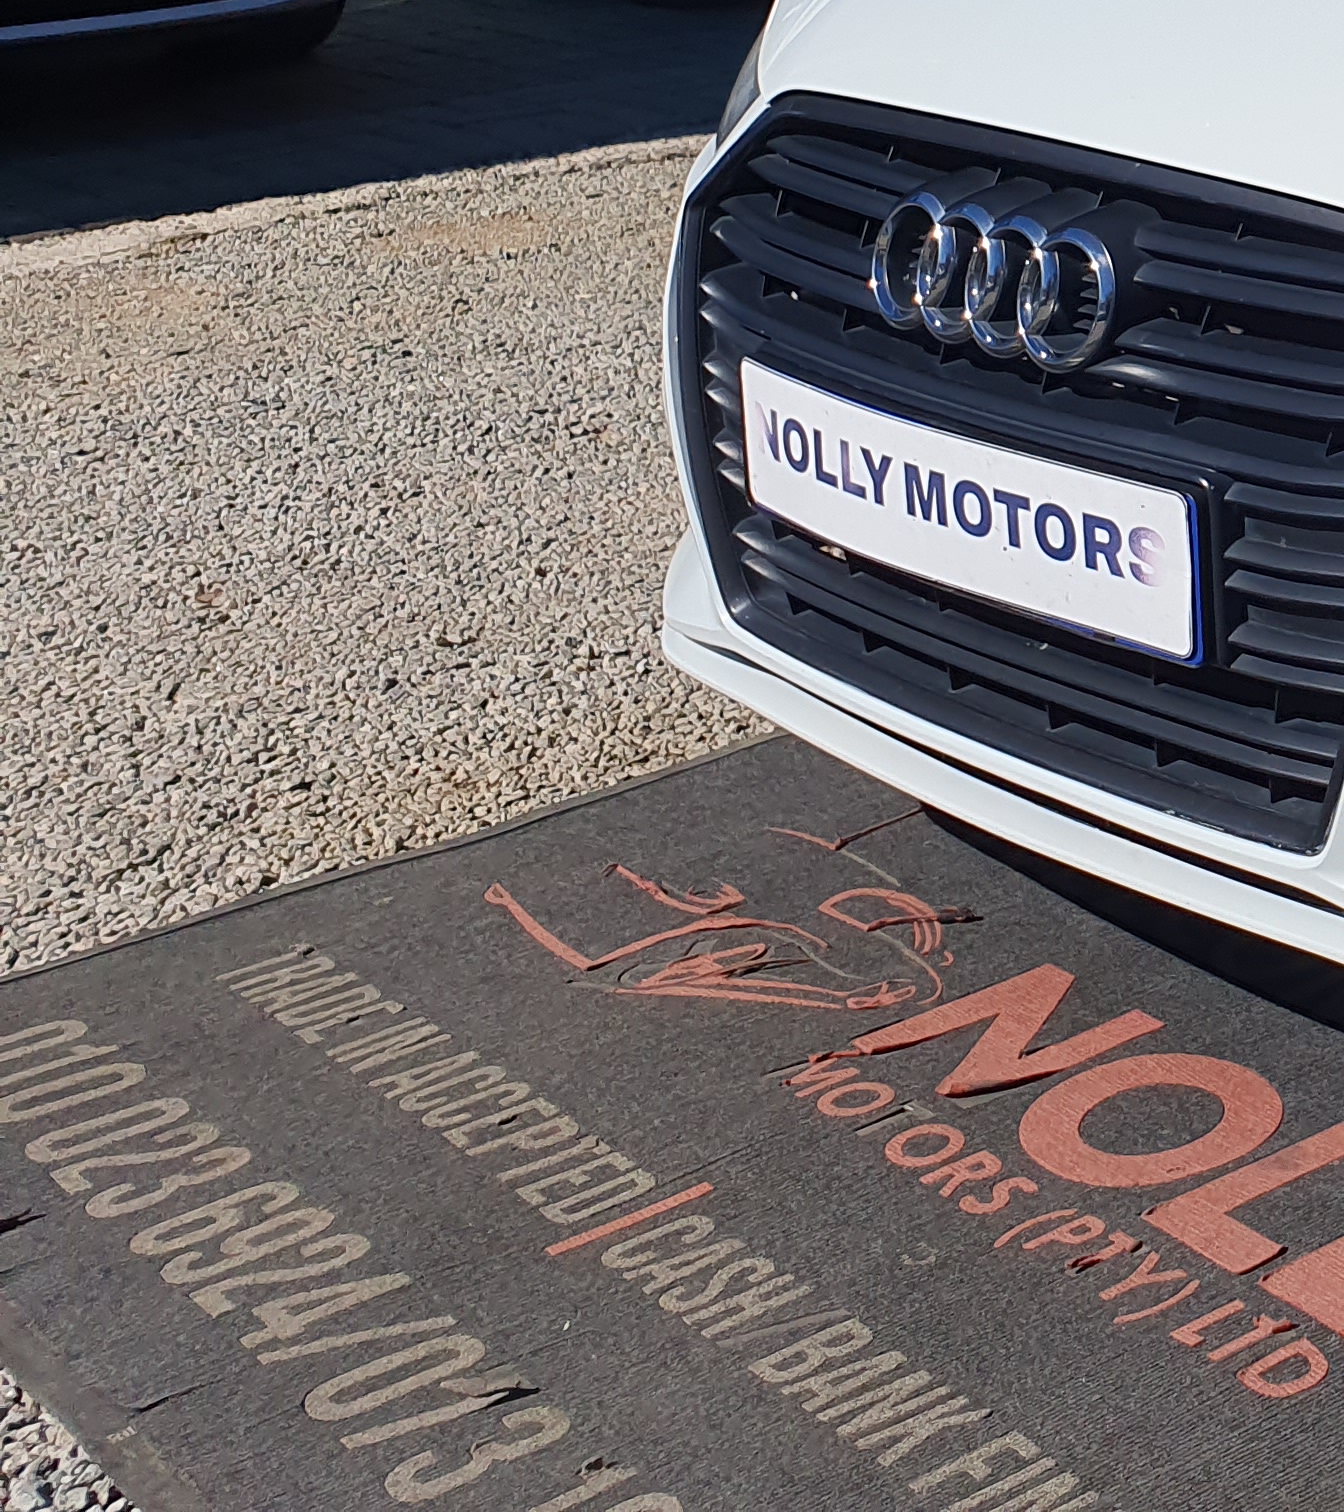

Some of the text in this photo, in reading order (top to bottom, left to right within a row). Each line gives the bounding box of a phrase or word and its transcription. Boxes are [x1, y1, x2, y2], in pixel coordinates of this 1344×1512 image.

[903, 463, 1167, 587] MOTORS
[216, 944, 406, 1044] TRADE
[325, 1016, 453, 1074] IN
[25, 1097, 252, 1218] 023
[366, 1049, 656, 1226] ACCEPTED
[993, 1208, 1201, 1324] (PTY)
[1169, 1298, 1330, 1399] LTD
